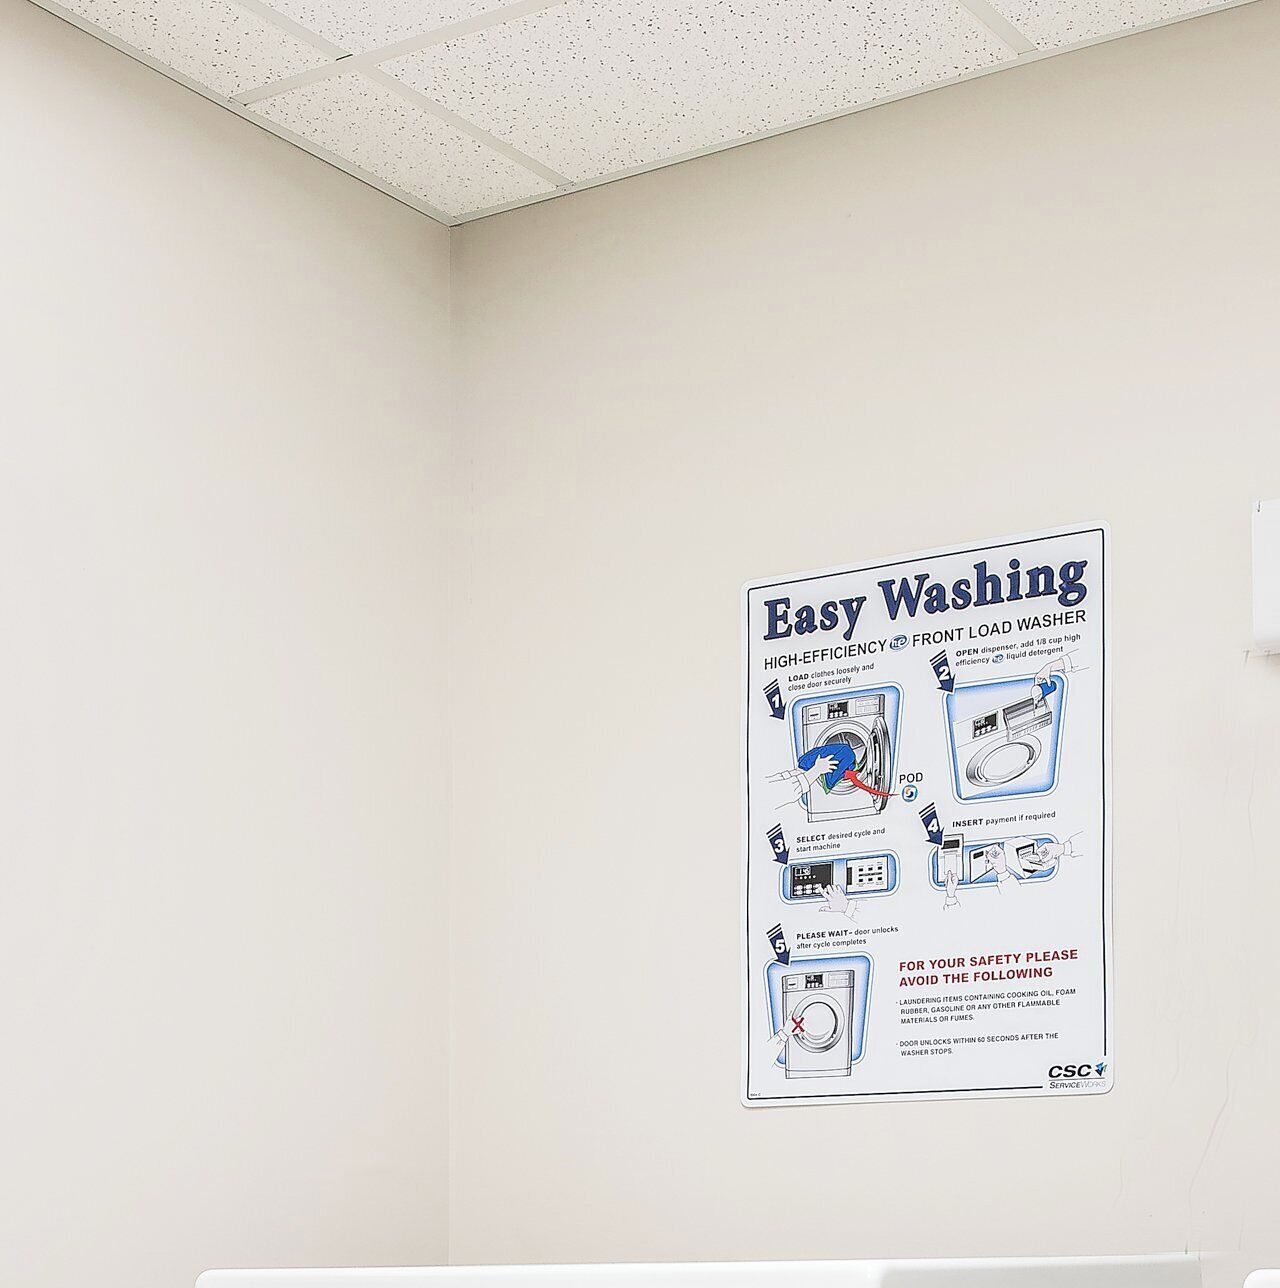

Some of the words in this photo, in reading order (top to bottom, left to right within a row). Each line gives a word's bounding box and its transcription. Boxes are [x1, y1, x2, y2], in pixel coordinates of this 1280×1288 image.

[763, 595, 867, 641] Easy
[877, 558, 1088, 620] Washing
[764, 638, 887, 670] HIGH-EFFICIENCY
[912, 627, 964, 647] FRONT
[968, 620, 1012, 639] LOAD
[1016, 609, 1086, 631] WASHER
[899, 771, 923, 786] POD
[952, 818, 983, 828] INSERT
[985, 815, 1016, 826] payment
[1018, 813, 1023, 821] if
[1025, 810, 1055, 821] required
[899, 960, 924, 972] FOR
[928, 957, 965, 969] YOUR
[969, 953, 1021, 966] SAFETY
[1025, 949, 1078, 962] PLEASE
[899, 974, 938, 987] AVOID
[942, 972, 969, 984] THE
[973, 966, 1052, 982] FOLLOWING
[1048, 1064, 1092, 1079] CSC
